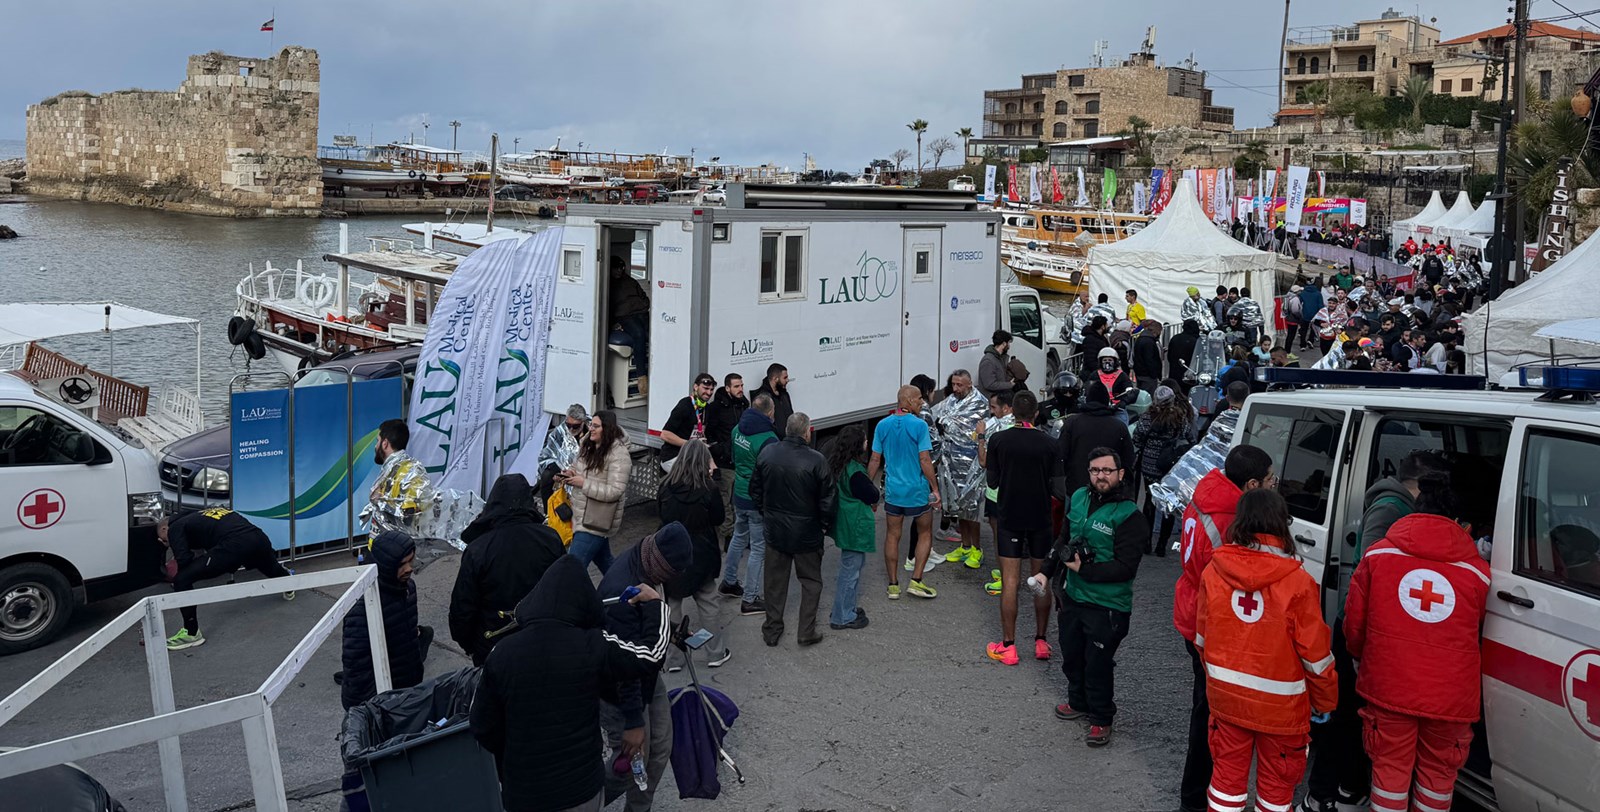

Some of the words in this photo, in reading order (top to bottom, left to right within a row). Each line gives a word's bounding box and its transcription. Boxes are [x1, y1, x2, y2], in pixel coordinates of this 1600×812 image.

[1289, 178, 1299, 209] ROLLING
[949, 250, 983, 261] mersaco
[817, 275, 870, 305] LAU
[438, 296, 468, 354] Medical
[517, 283, 533, 342] Center
[554, 306, 572, 318] LAU
[730, 338, 758, 356] LAU
[830, 335, 842, 344] LAU
[477, 354, 487, 380] Medical
[473, 380, 484, 414] University
[493, 347, 530, 464] LAU
[241, 407, 266, 418] LAU
[415, 356, 461, 476] LAU
[239, 439, 269, 447] HEALING
[239, 450, 283, 459] COMPASSION
